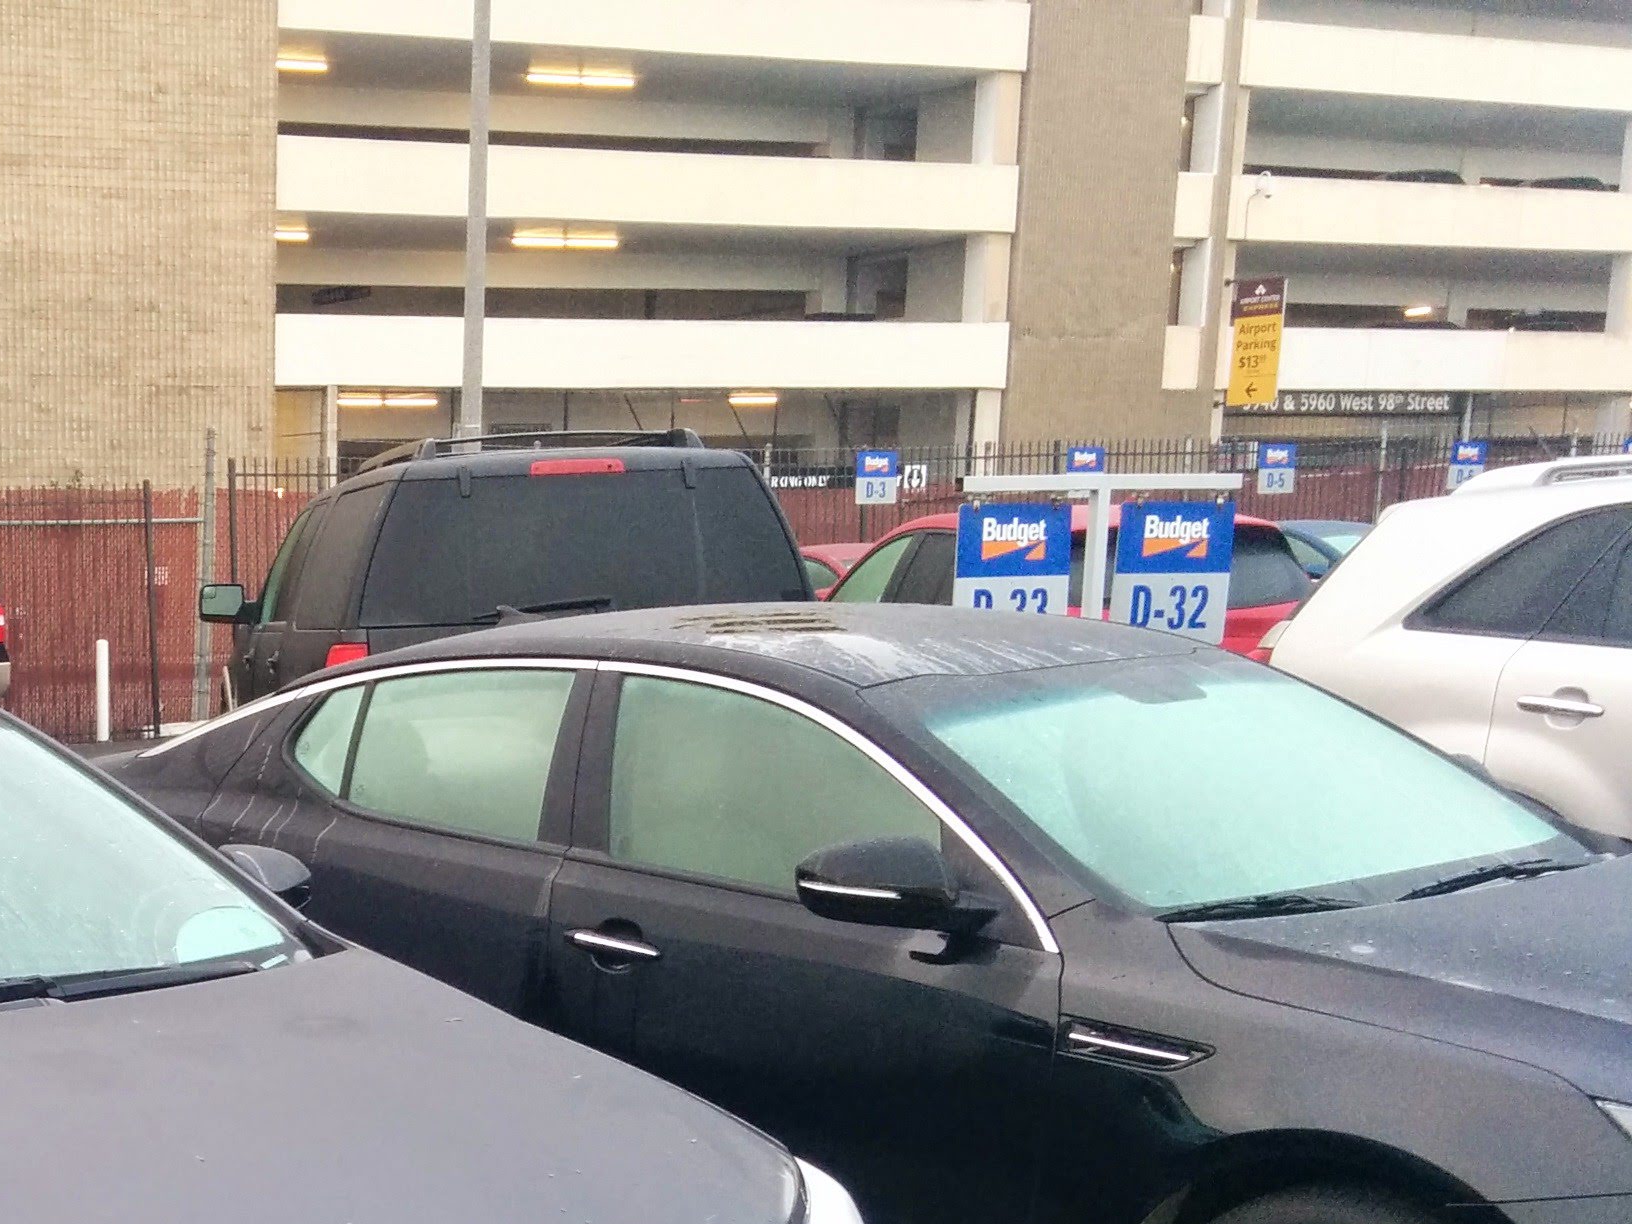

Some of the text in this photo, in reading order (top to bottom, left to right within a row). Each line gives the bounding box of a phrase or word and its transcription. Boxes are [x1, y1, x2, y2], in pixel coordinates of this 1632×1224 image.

[1239, 322, 1277, 337] Airport
[1236, 339, 1277, 352] Parking
[1283, 394, 1295, 411] &
[1300, 393, 1336, 412] 5960
[1340, 393, 1374, 412] West
[1407, 393, 1450, 412] Street
[866, 481, 886, 498] D-3
[982, 517, 1048, 548] Budget
[1143, 514, 1210, 545] Budget
[1129, 584, 1209, 630] D-32
